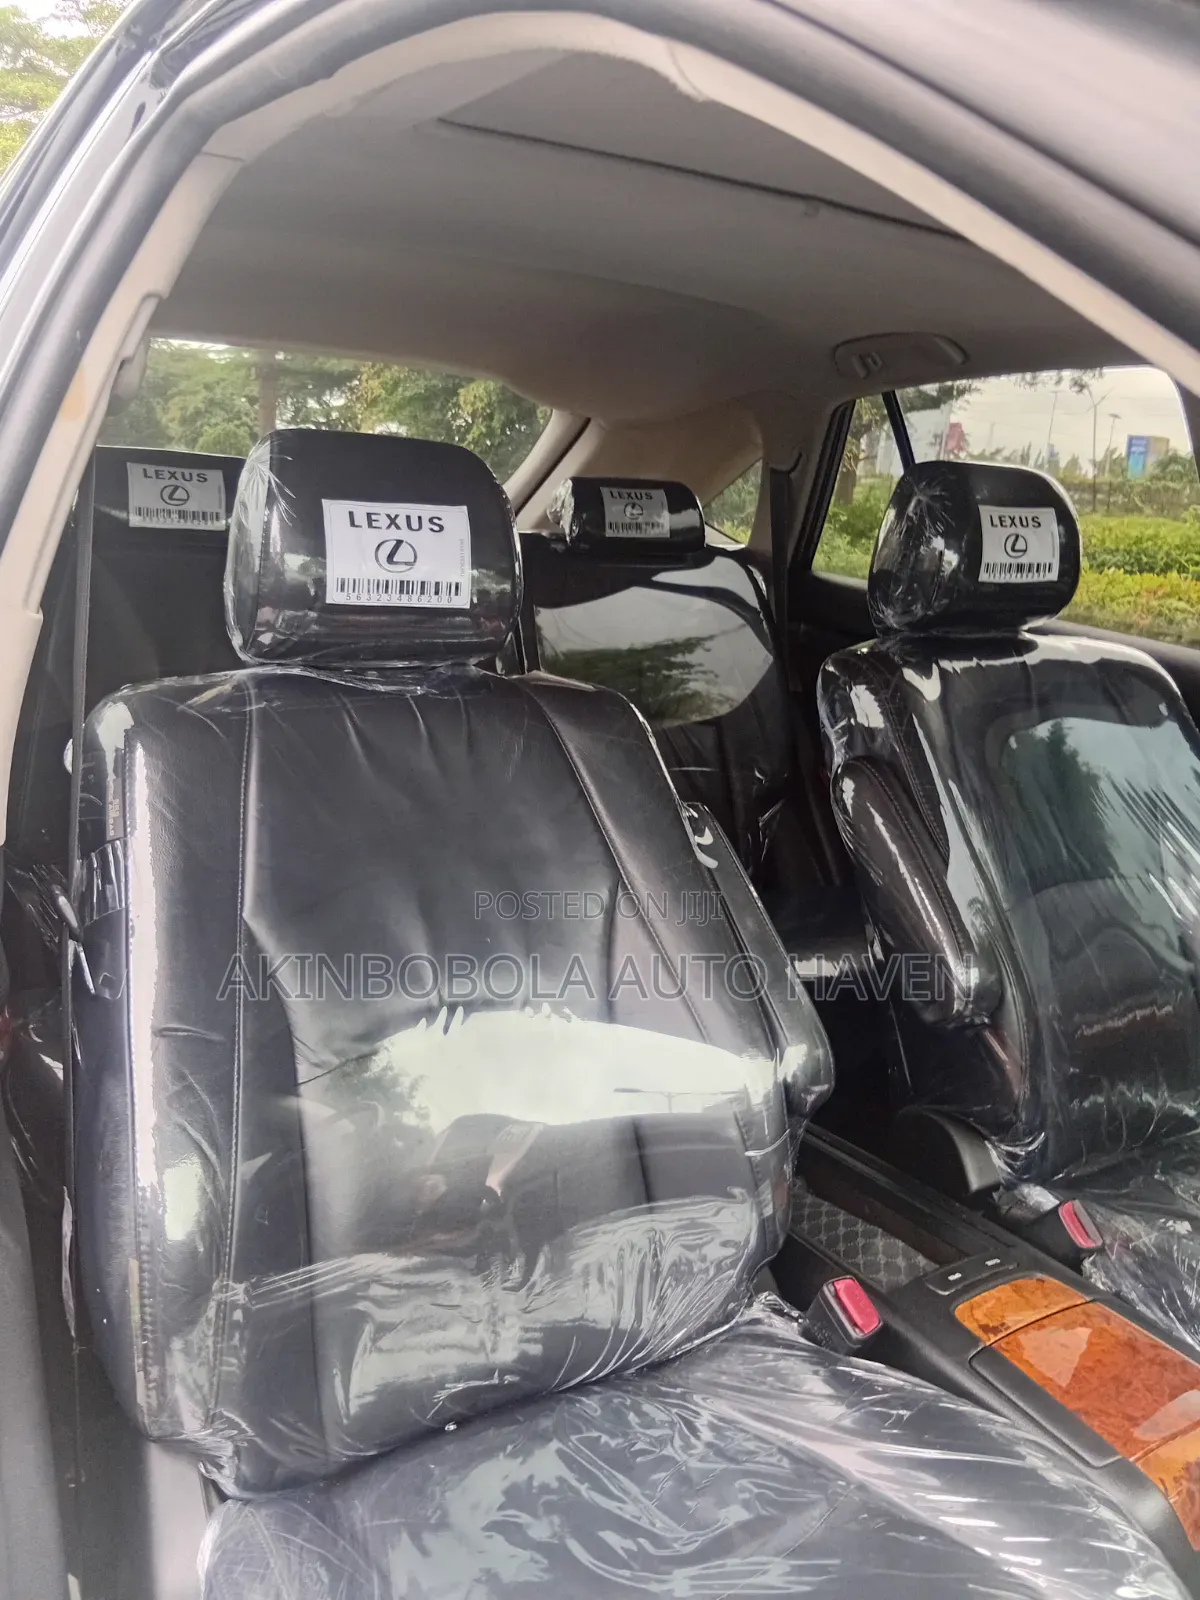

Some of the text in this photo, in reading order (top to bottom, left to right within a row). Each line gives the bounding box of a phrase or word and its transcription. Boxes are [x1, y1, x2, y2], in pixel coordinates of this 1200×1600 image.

[142, 467, 208, 483] LEXUS
[609, 490, 653, 500] LEXUS
[348, 510, 445, 533] LEXUS
[989, 514, 1042, 529] LEXUS
